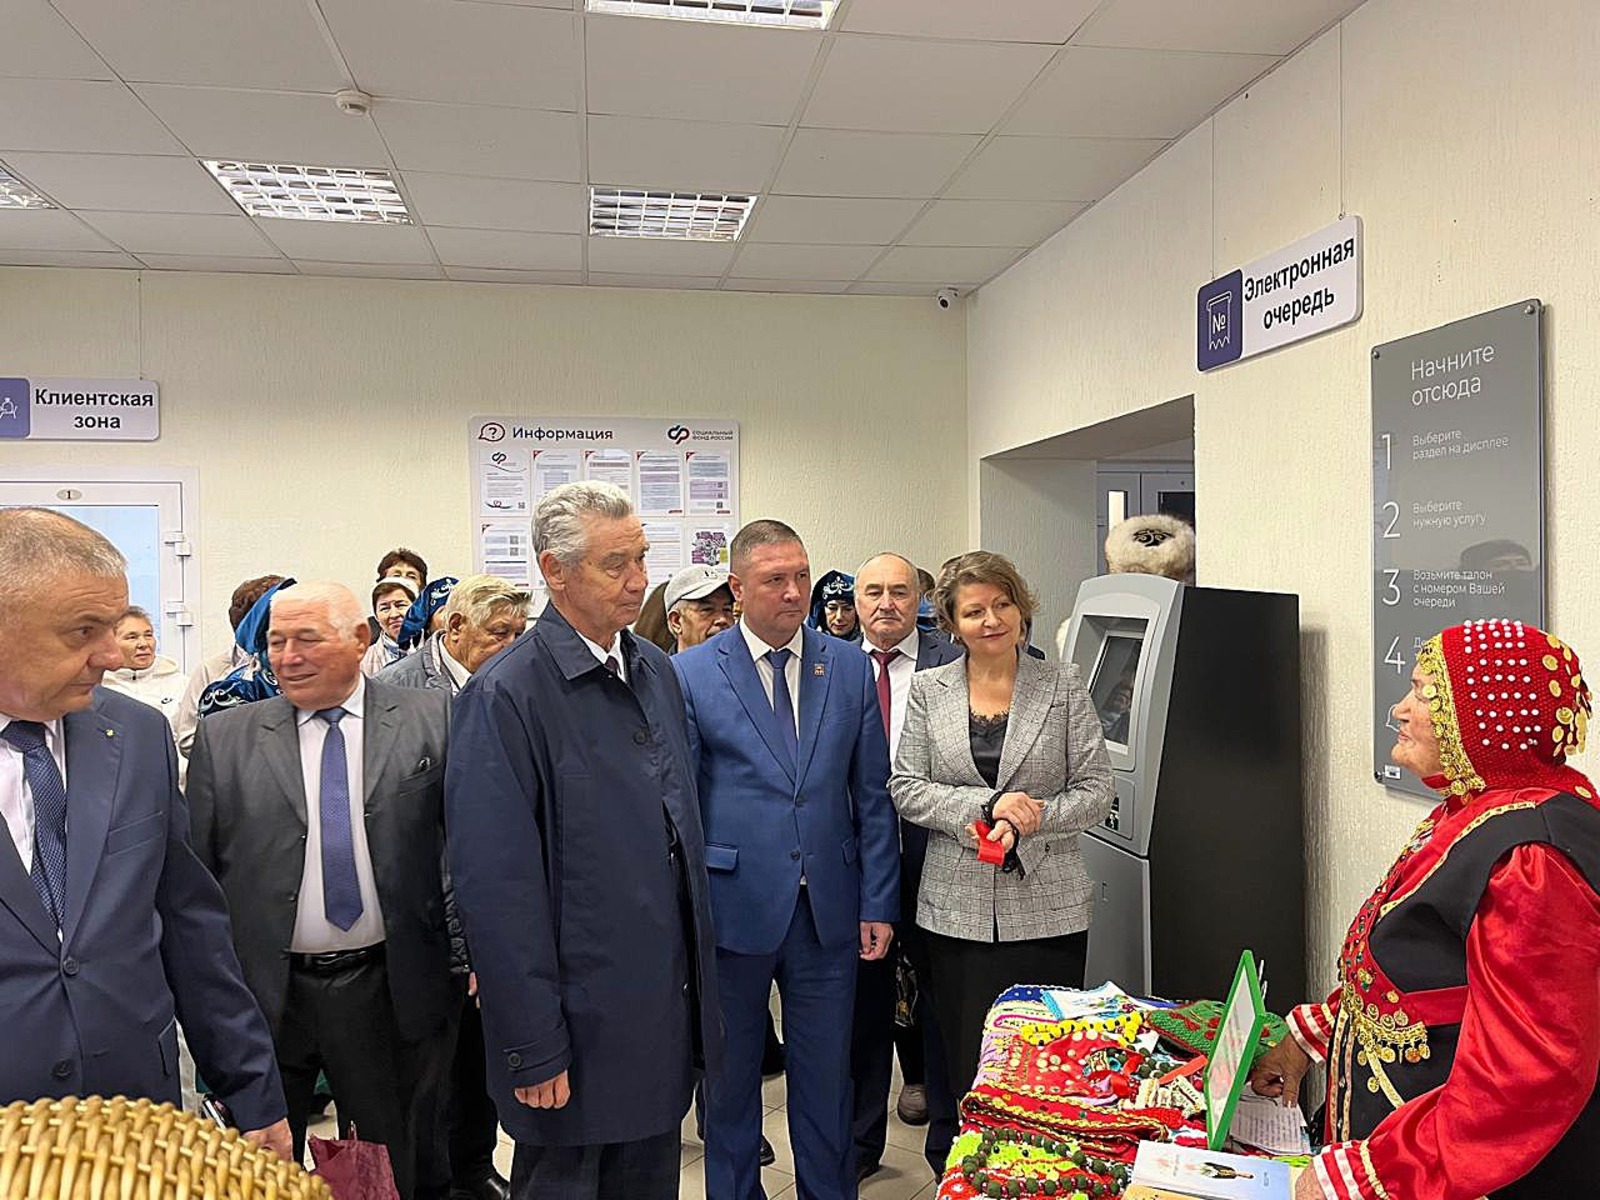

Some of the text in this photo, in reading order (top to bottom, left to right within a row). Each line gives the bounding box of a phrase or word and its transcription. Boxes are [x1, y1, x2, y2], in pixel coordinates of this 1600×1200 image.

[1244, 237, 1355, 301] Электронная
[1263, 287, 1335, 330] очередь
[1212, 312, 1226, 335] №
[1410, 345, 1495, 381] Начните
[35, 388, 153, 407] Клиентская
[1411, 376, 1481, 406] отсюда
[73, 415, 121, 429] зона
[488, 427, 498, 439] ?
[512, 426, 613, 441] Информация
[1413, 430, 1461, 446] Выберите
[1381, 433, 1391, 470] 1
[1413, 436, 1509, 460] раздел на дисплее
[1413, 500, 1462, 514] Выберите
[1382, 501, 1400, 539] 2
[1413, 511, 1486, 530] нужную услугу
[1413, 569, 1493, 581] Возьмите талон
[1382, 568, 1401, 606] 3
[1413, 581, 1506, 596] с номером Вашей
[1413, 598, 1456, 609] очереди
[1384, 636, 1406, 674] 4
